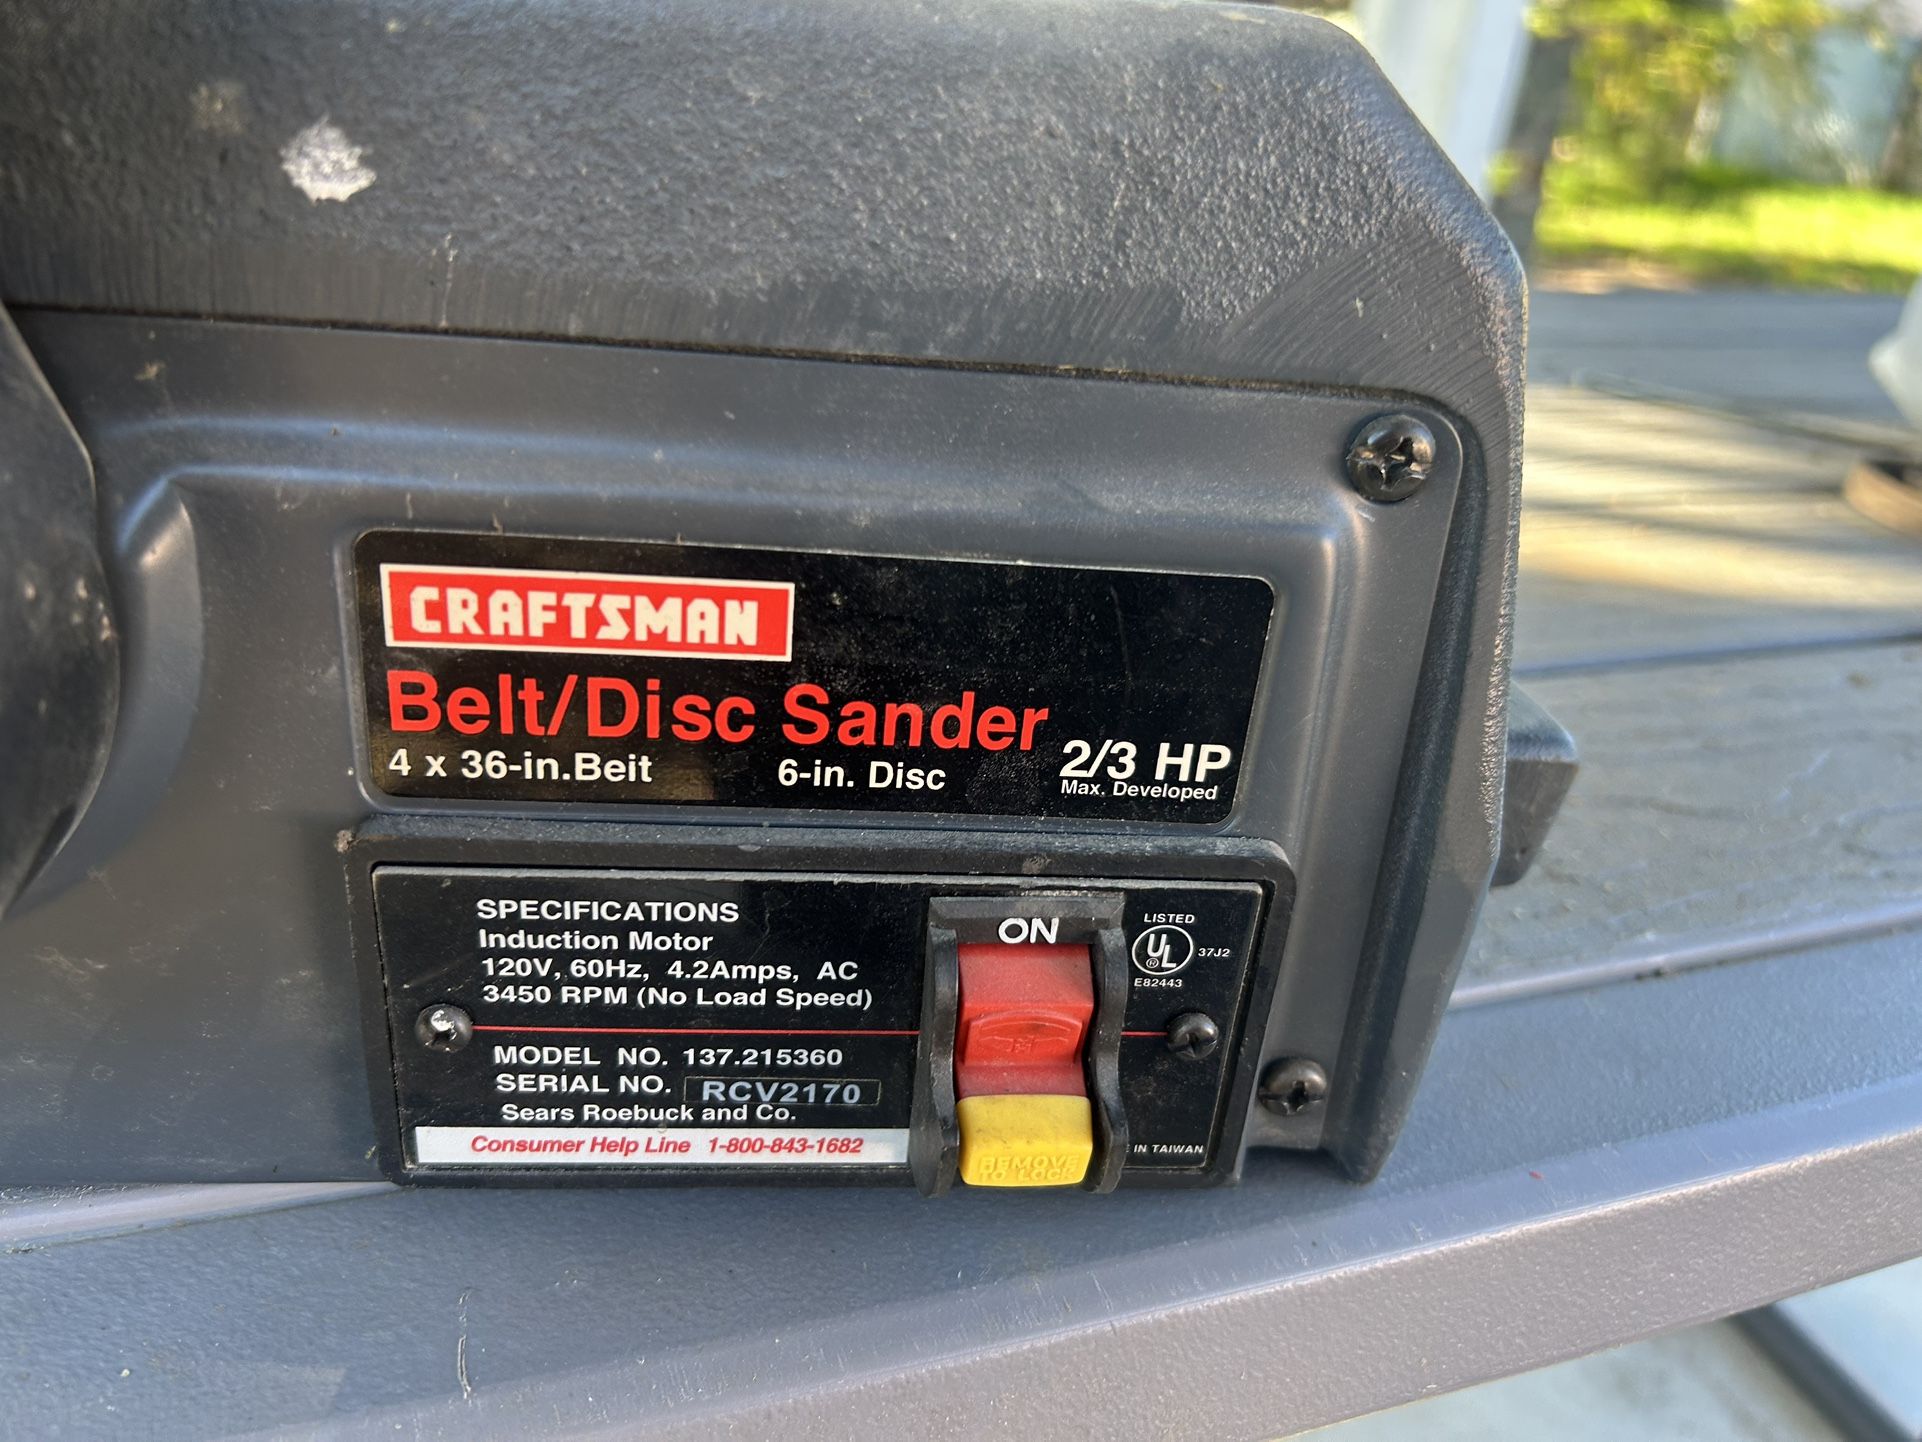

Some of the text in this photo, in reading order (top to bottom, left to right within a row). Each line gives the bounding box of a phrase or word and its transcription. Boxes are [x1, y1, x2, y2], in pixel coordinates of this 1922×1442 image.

[409, 585, 759, 647] CRAFTSMAN
[387, 669, 1049, 751] Belt/Disc Sander
[389, 749, 411, 777] 4
[425, 756, 447, 777] x
[1059, 739, 1232, 783] 2/3 HP
[777, 759, 946, 790] 6-in. Disc
[1061, 779, 1218, 802] Max. Developed
[476, 898, 740, 923] SPECIFICATIONS
[1143, 913, 1195, 924] LISTED
[478, 928, 714, 952] Induction Motor
[998, 916, 1060, 945] ON
[1197, 948, 1231, 958] 37J2
[482, 957, 859, 984] 120V, 60Hz, 4.2Amps, AC
[1133, 978, 1183, 988] E82443
[483, 984, 873, 1011] 3450 RPM (No Load Speed)
[494, 1046, 843, 1066] MODEL NO. 137.215360
[496, 1073, 862, 1104] SERIAL NO. RCV2170
[501, 1103, 797, 1122] Sears Roebuck and Co.
[471, 1135, 865, 1157] Consumer Help Line 1-800-843-1682
[1133, 1144, 1147, 1153] IN
[1152, 1144, 1204, 1154] TAIWAN
